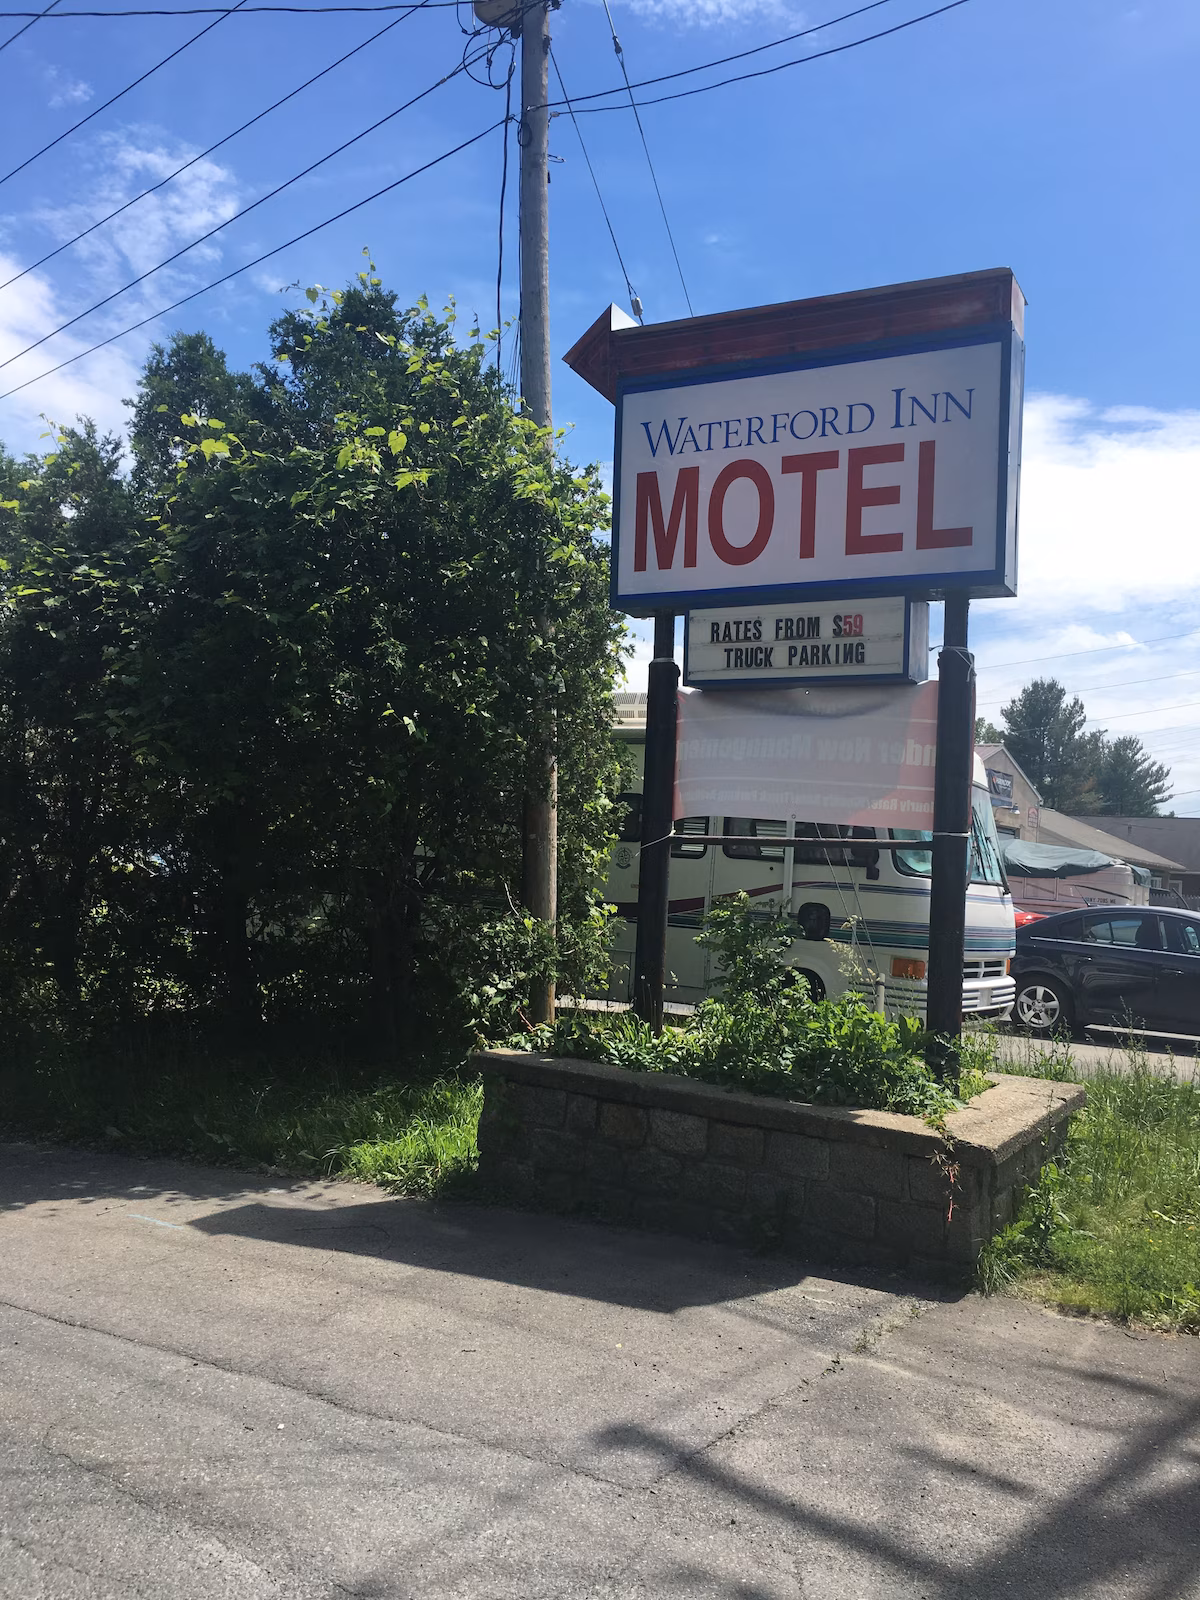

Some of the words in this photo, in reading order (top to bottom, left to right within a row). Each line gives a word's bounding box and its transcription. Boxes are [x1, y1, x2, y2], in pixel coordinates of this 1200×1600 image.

[640, 402, 875, 458] WATERFORD
[890, 387, 975, 429] INN
[633, 439, 973, 572] MOTEL
[711, 619, 762, 642] RATES
[775, 616, 820, 639] FROM
[724, 646, 773, 668] TRUCK
